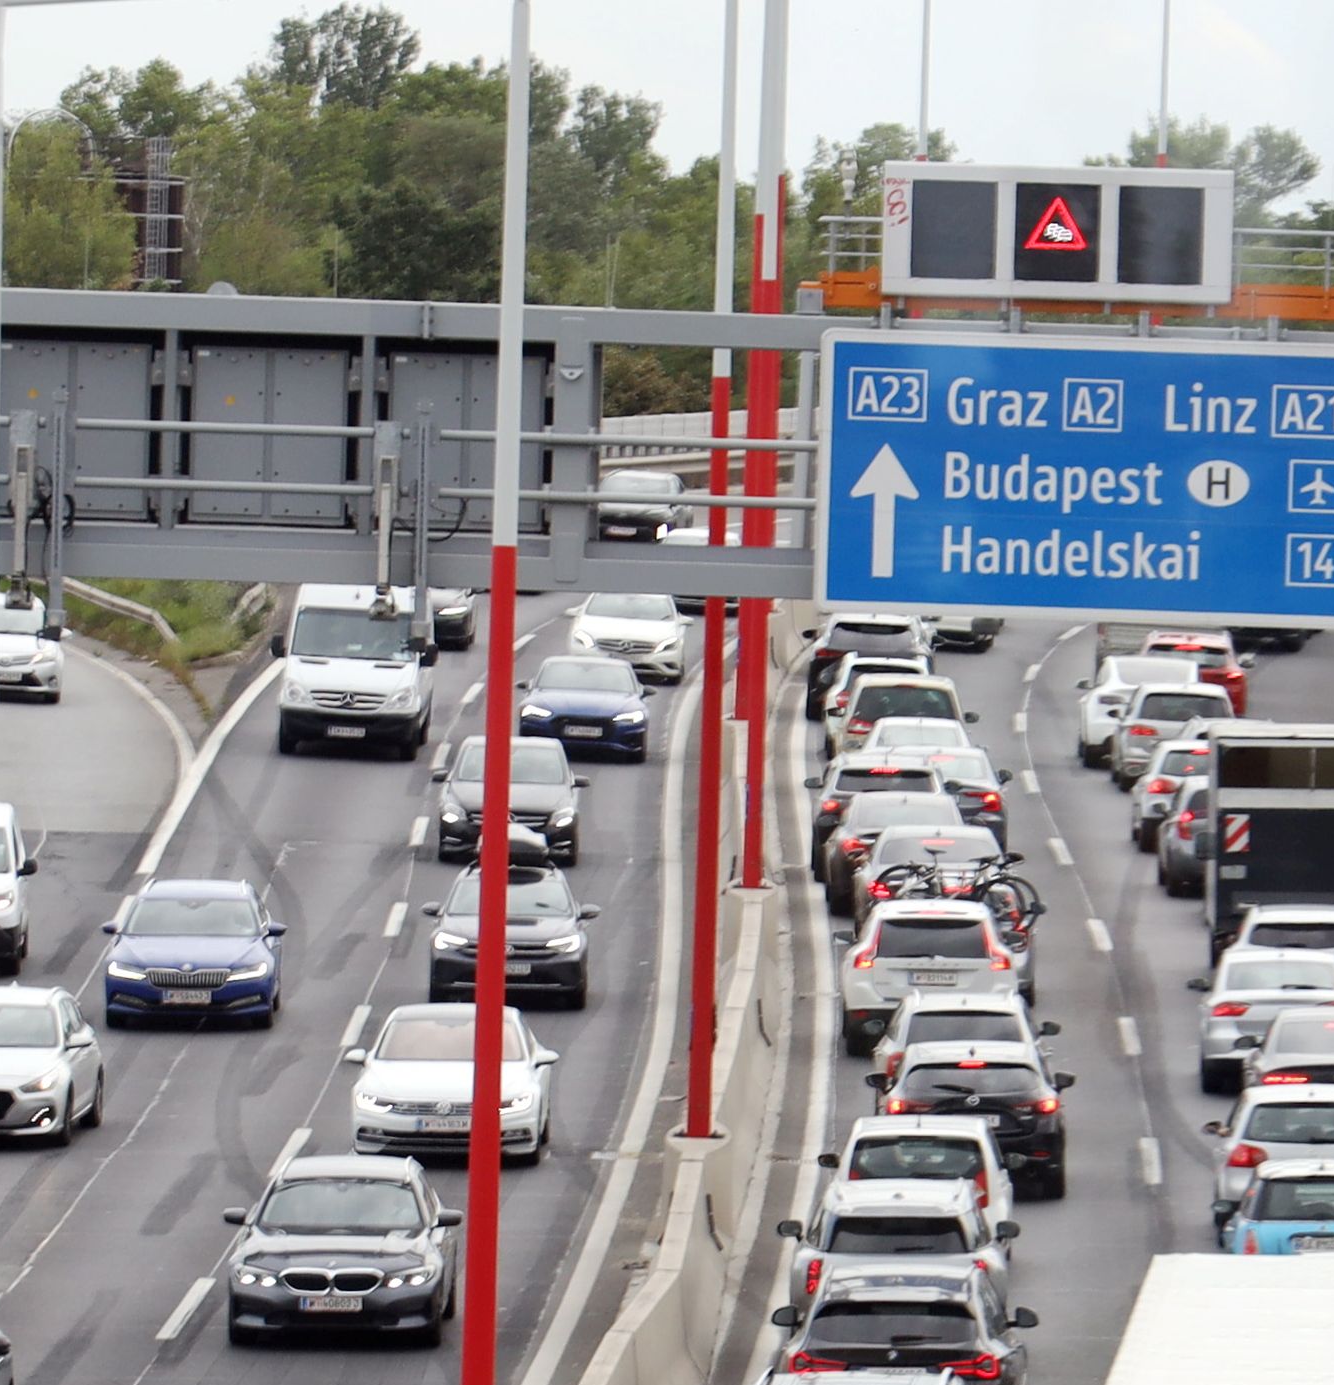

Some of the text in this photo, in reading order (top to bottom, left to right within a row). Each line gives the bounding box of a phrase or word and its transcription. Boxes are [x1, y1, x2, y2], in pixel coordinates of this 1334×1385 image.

[855, 376, 919, 416] A23
[947, 377, 1049, 427] Graz
[1071, 385, 1117, 427] A2
[1166, 383, 1257, 433] Linz
[944, 451, 1163, 513] Budapest
[1207, 467, 1231, 500] H
[942, 524, 1334, 581] Handelskai 14
